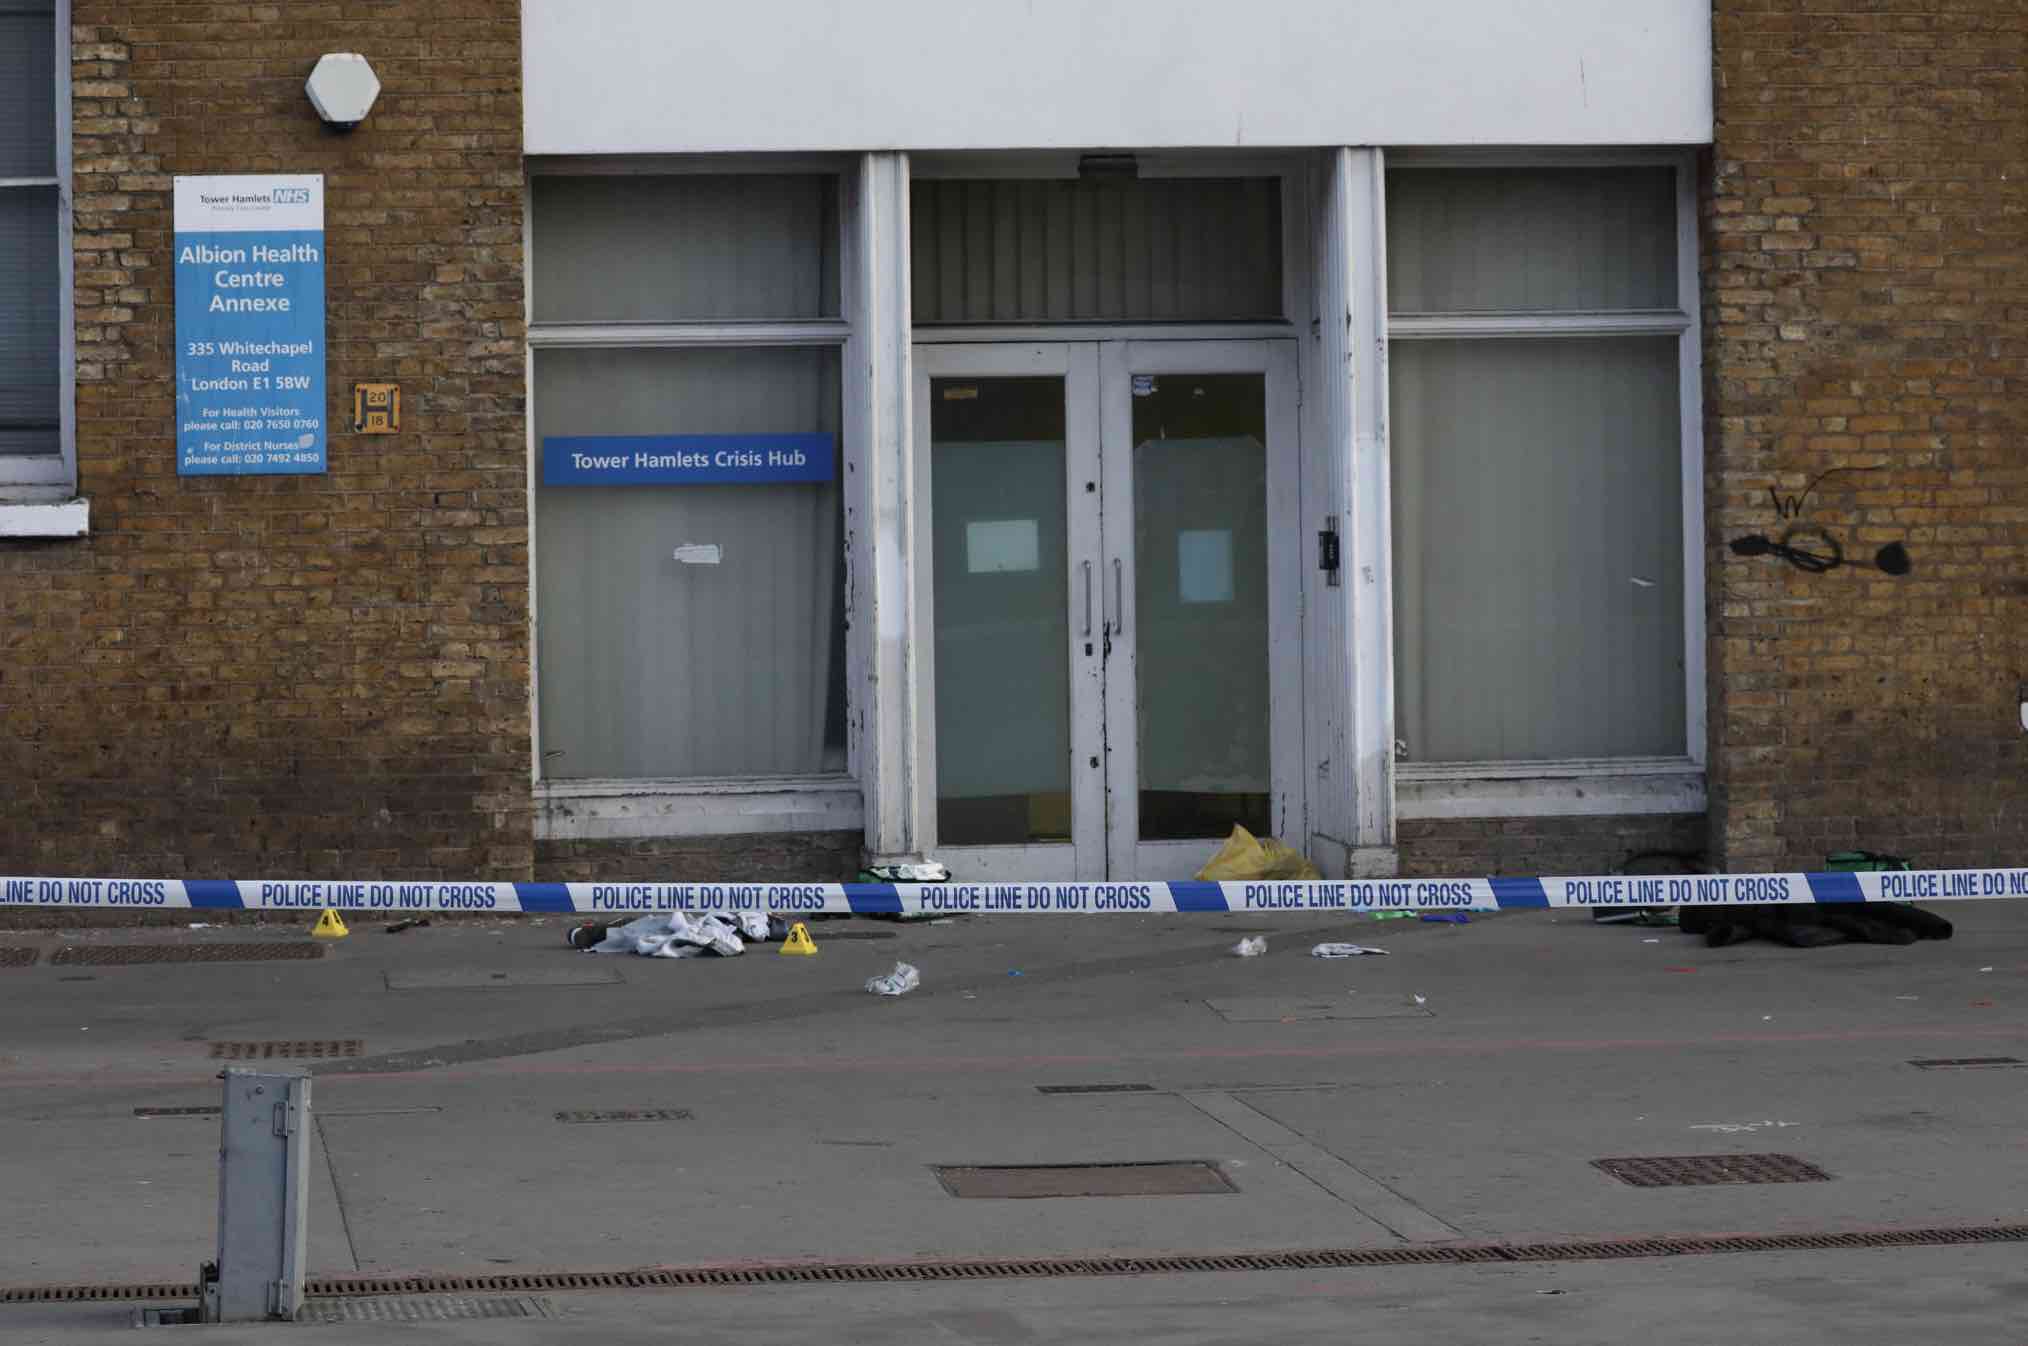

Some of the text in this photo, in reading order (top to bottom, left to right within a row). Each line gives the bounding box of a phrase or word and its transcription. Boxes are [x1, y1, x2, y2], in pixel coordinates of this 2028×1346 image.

[200, 188, 308, 204] Tower Hamlets NHS
[180, 243, 319, 264] Albion Health
[215, 270, 285, 288] Centre
[209, 295, 290, 312] Annexe
[187, 341, 312, 357] 335 Whitechapel
[232, 359, 270, 372] Road
[192, 376, 310, 391] London E1 5BW
[202, 407, 299, 417] For Health Visitors
[371, 415, 384, 425] 18
[184, 421, 218, 432] please
[220, 420, 240, 430] call:
[243, 420, 263, 430] 020
[204, 440, 298, 451] For District Nurses
[184, 455, 218, 466] please
[221, 454, 241, 464] call:
[244, 454, 263, 464] 020
[572, 450, 806, 469] Tower Hamlets Crisis Hub
[39, 881, 62, 904] DO
[68, 881, 102, 905] NOT
[108, 882, 165, 905] CROSS
[1565, 877, 1789, 904] POLICE LINE DO NOT CROSS
[1880, 874, 1938, 898] POLICE
[1942, 873, 1978, 897] LINE
[1982, 872, 2005, 895] DO
[262, 883, 496, 909] POLICE LINE DO NOT CROSS
[592, 886, 825, 910] POLICE LINE DO NOT CROSS
[920, 885, 1150, 910] POLICE LINE DO NOT CROSS
[1245, 882, 1472, 908] POLICE LINE DO NOT CROSS
[791, 931, 798, 943] 3
